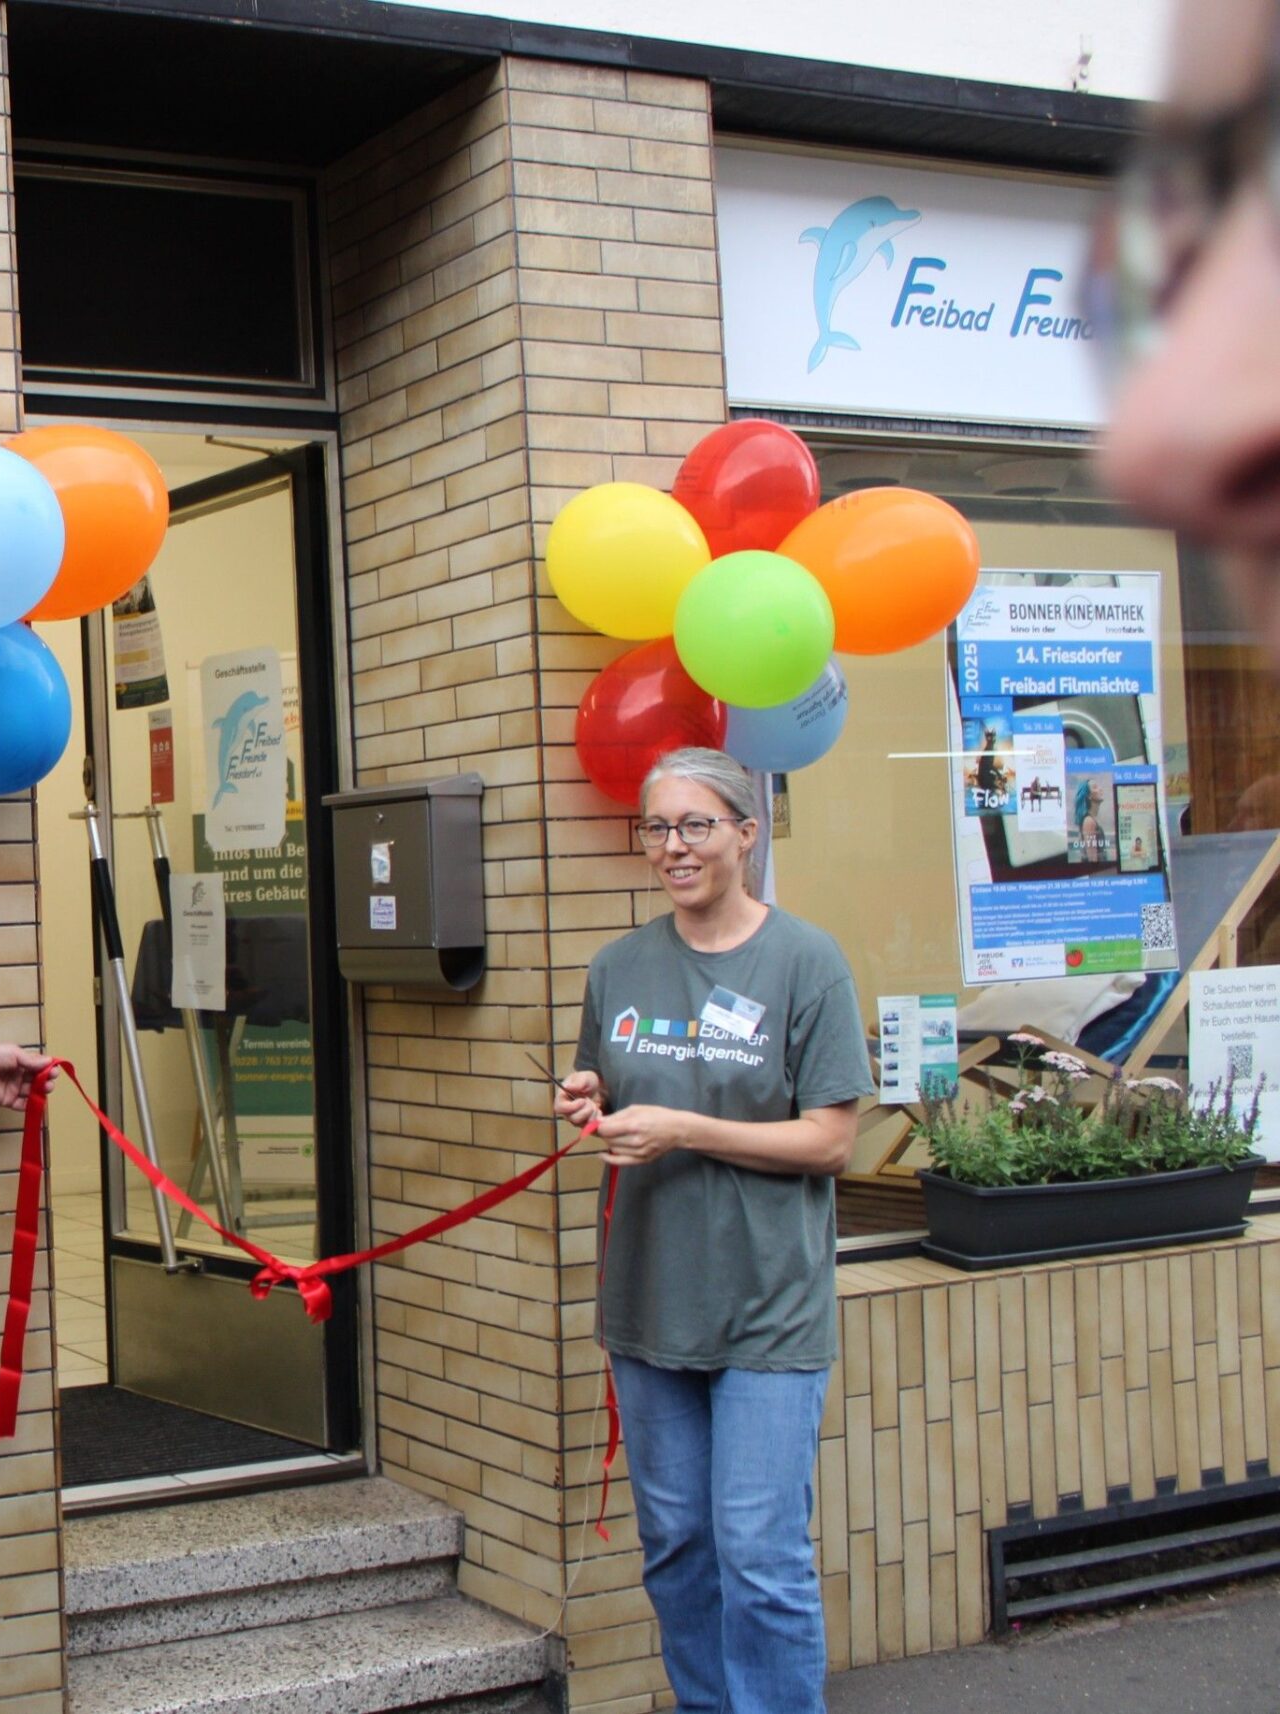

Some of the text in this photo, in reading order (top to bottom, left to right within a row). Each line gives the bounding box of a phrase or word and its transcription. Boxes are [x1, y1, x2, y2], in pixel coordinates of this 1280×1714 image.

[890, 257, 995, 332] Freibad
[1009, 603, 1062, 620] BONNER
[1064, 604, 1144, 621] KINEMATHEK
[1011, 625, 1030, 634] kino
[1032, 625, 1040, 633] in
[1042, 625, 1056, 634] der
[1017, 647, 1122, 664] 14. Friesdorfer
[215, 662, 267, 679] Geschäftsstelle
[964, 642, 979, 693] 2025
[1001, 676, 1140, 694] Freibad Filmnächte
[971, 788, 1009, 809] Flow
[1073, 839, 1111, 848] OUTRUN
[253, 868, 277, 880] um
[280, 864, 303, 879] die
[1203, 983, 1276, 995] Die Sachen hier im
[1202, 998, 1278, 1011] Schaufenster könnt
[1200, 1018, 1210, 1027] Ihr
[1212, 1016, 1232, 1026] Euch
[1233, 1015, 1252, 1024] nach
[243, 1039, 275, 1050] Termin
[637, 1038, 765, 1067] Energie Agentur
